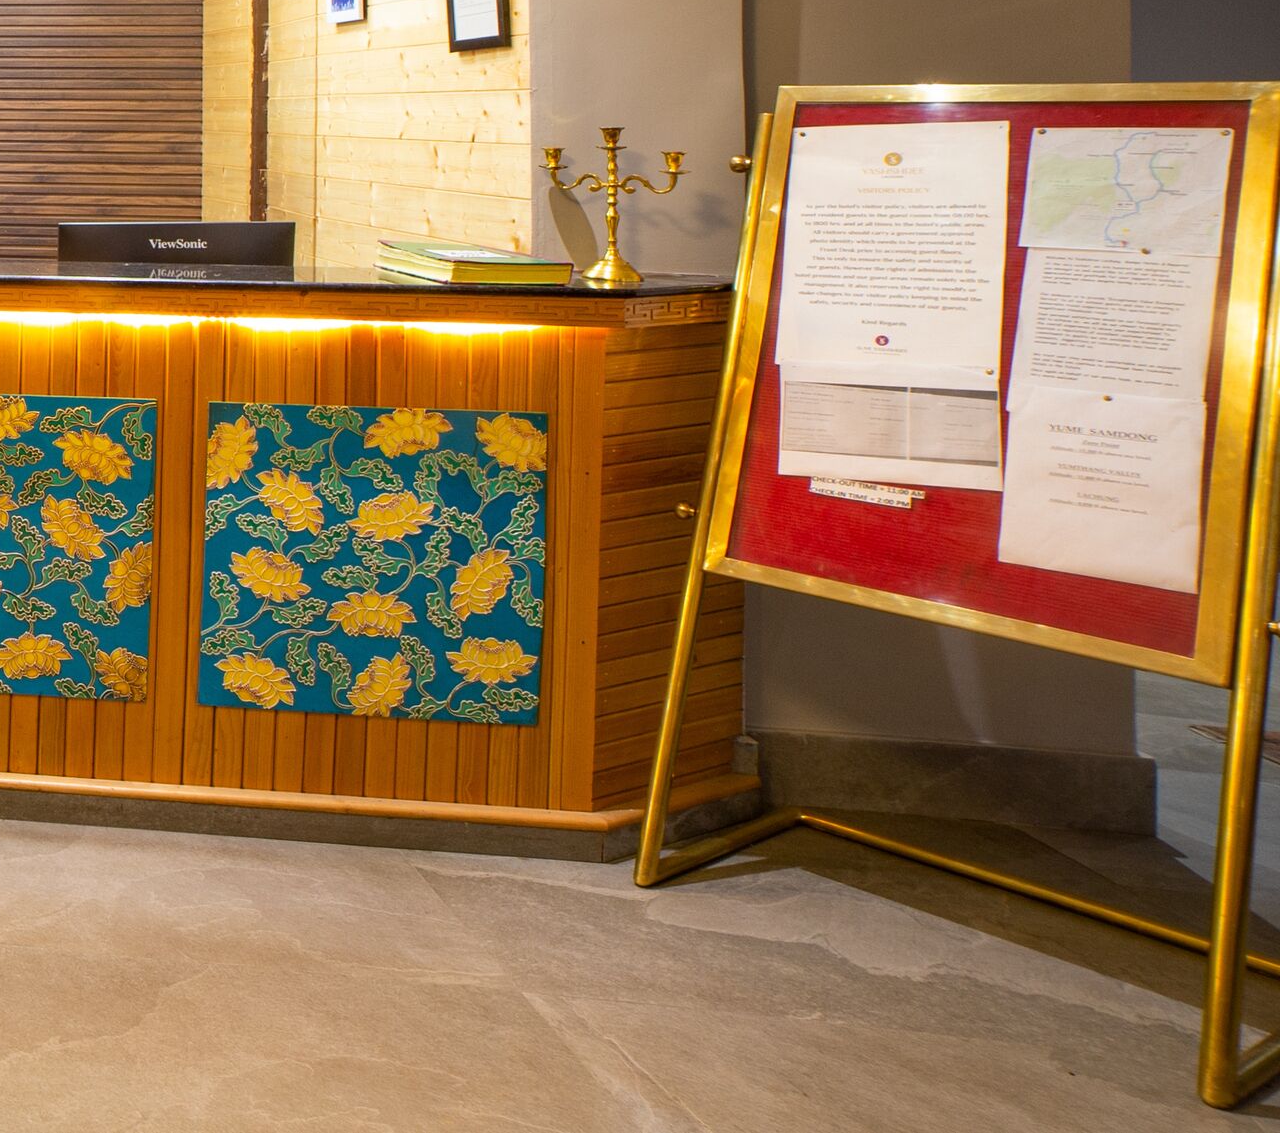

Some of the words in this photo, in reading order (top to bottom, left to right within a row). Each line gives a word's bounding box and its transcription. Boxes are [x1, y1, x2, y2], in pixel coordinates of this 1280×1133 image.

[148, 238, 209, 249] ViewSonic
[1048, 423, 1083, 434] YUME
[1089, 428, 1158, 443] SAMDONG
[812, 475, 856, 487] CHECK-OUT
[858, 481, 878, 491] TIME
[886, 486, 909, 496] 11:00
[911, 489, 925, 497] AM
[849, 492, 868, 501] TIME
[877, 496, 895, 505] 2:00
[896, 498, 910, 508] PM
